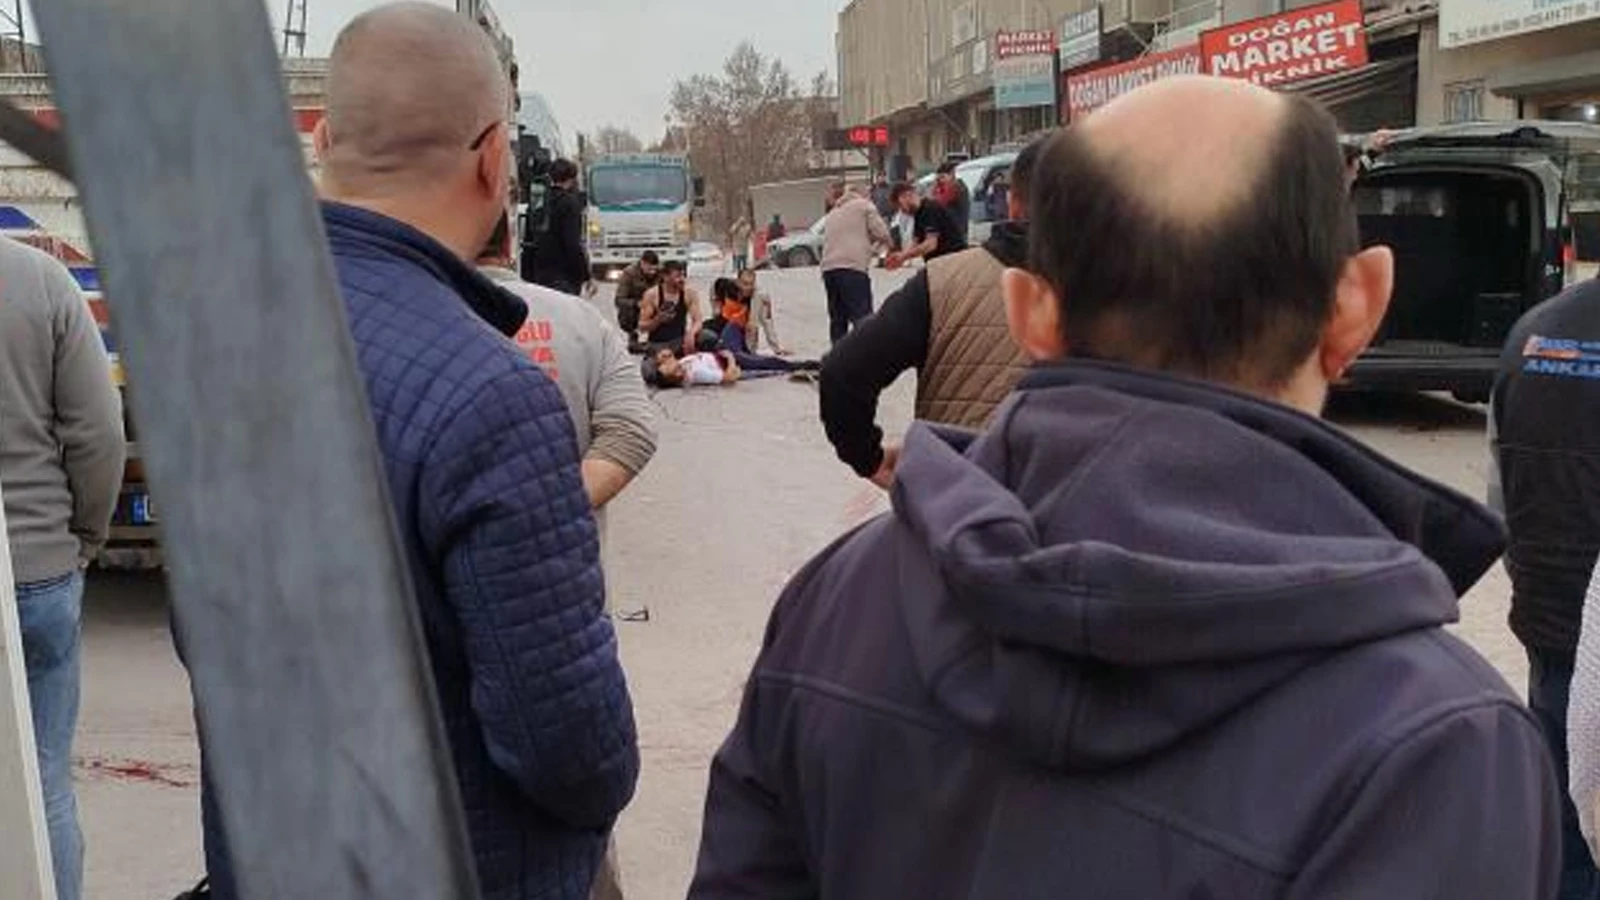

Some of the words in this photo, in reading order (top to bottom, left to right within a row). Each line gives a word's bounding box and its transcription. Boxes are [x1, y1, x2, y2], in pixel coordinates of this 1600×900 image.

[1228, 12, 1335, 47] DOĞAN
[1211, 22, 1361, 76] MARKET
[1251, 55, 1347, 86] İKNİK
